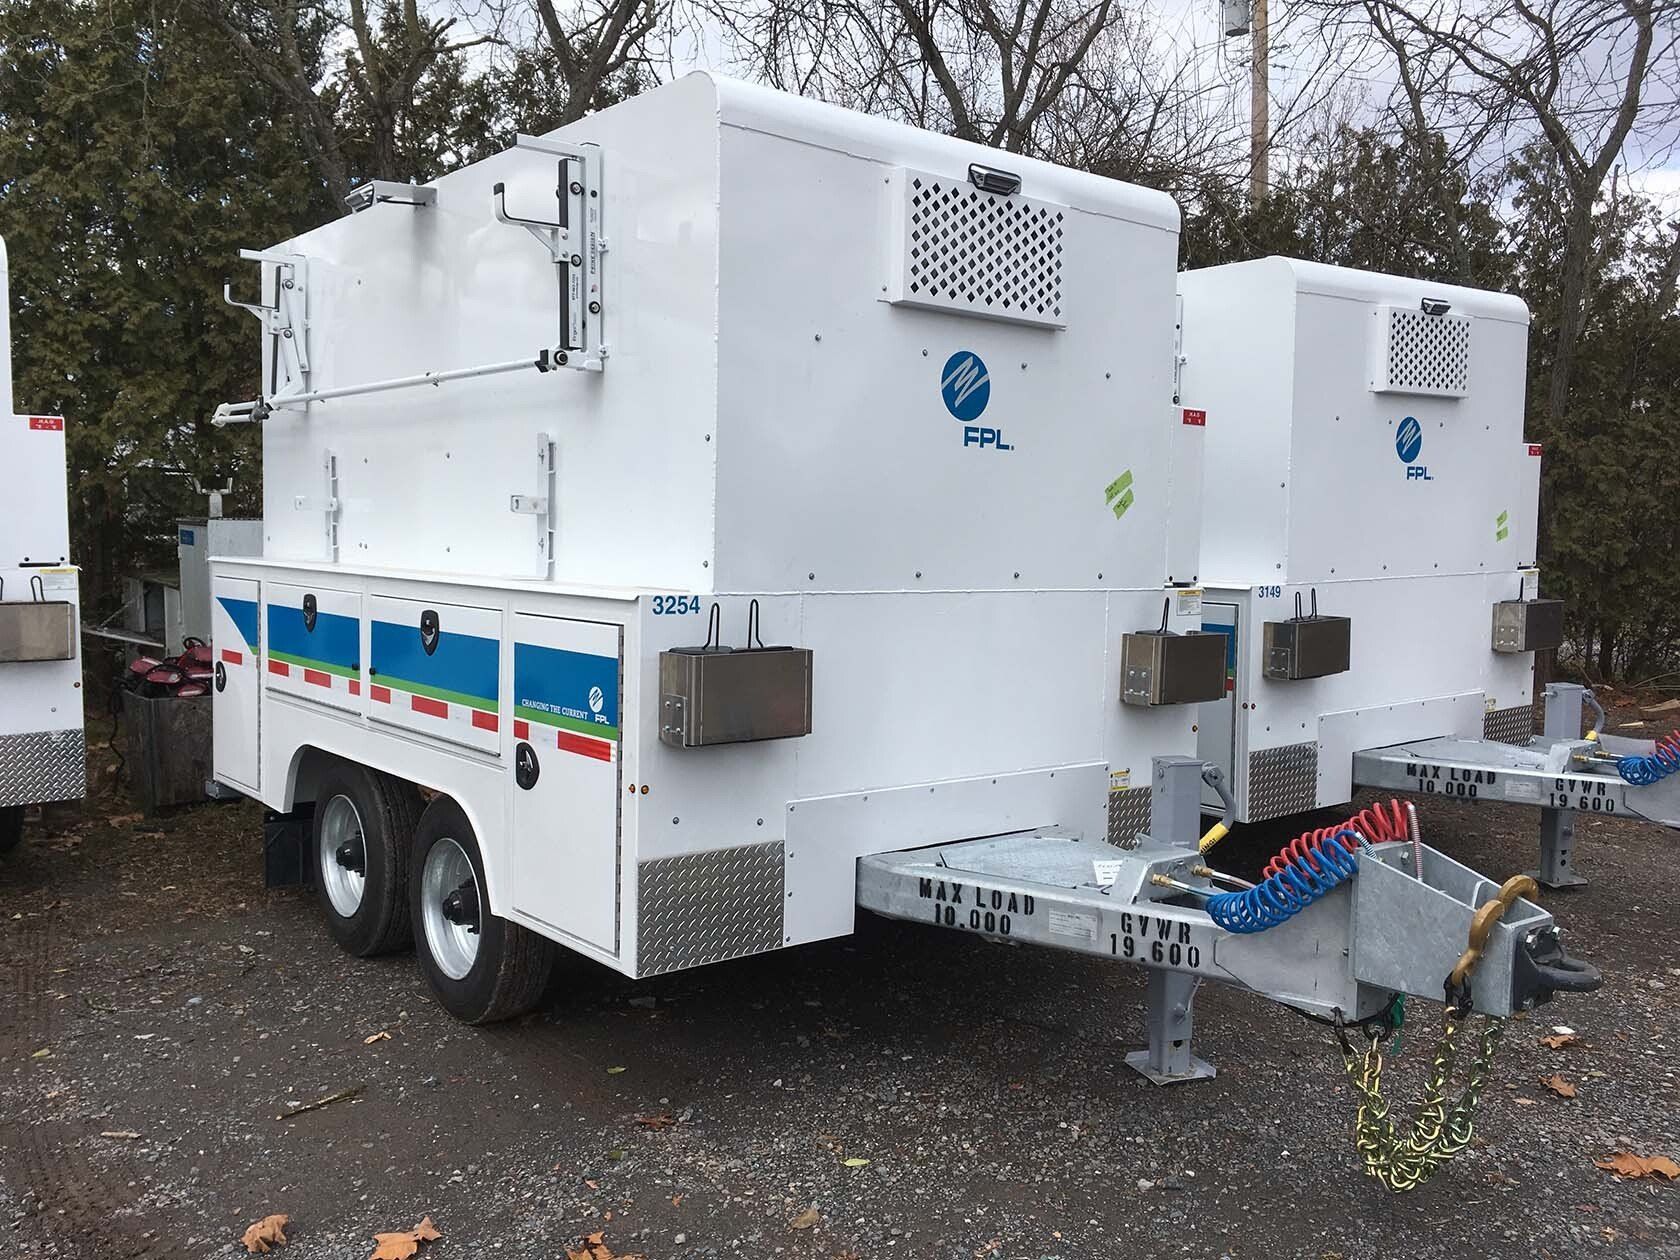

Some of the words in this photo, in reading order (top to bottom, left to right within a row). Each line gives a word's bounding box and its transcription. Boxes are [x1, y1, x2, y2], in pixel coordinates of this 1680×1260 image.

[964, 426, 1010, 450] FPL
[1407, 466, 1431, 480] FPL
[1259, 585, 1281, 598] 3149
[652, 595, 700, 615] 3254
[522, 698, 549, 712] CHANGING
[550, 704, 561, 714] THE
[562, 706, 588, 720] CURRENT
[595, 714, 609, 725] FPL
[1406, 763, 1440, 779] MAX
[1451, 768, 1496, 785] LOAD
[1555, 778, 1606, 796] GVWR
[919, 877, 962, 904] MAX
[976, 886, 1035, 915] LOAD
[1121, 912, 1191, 945] GVWR
